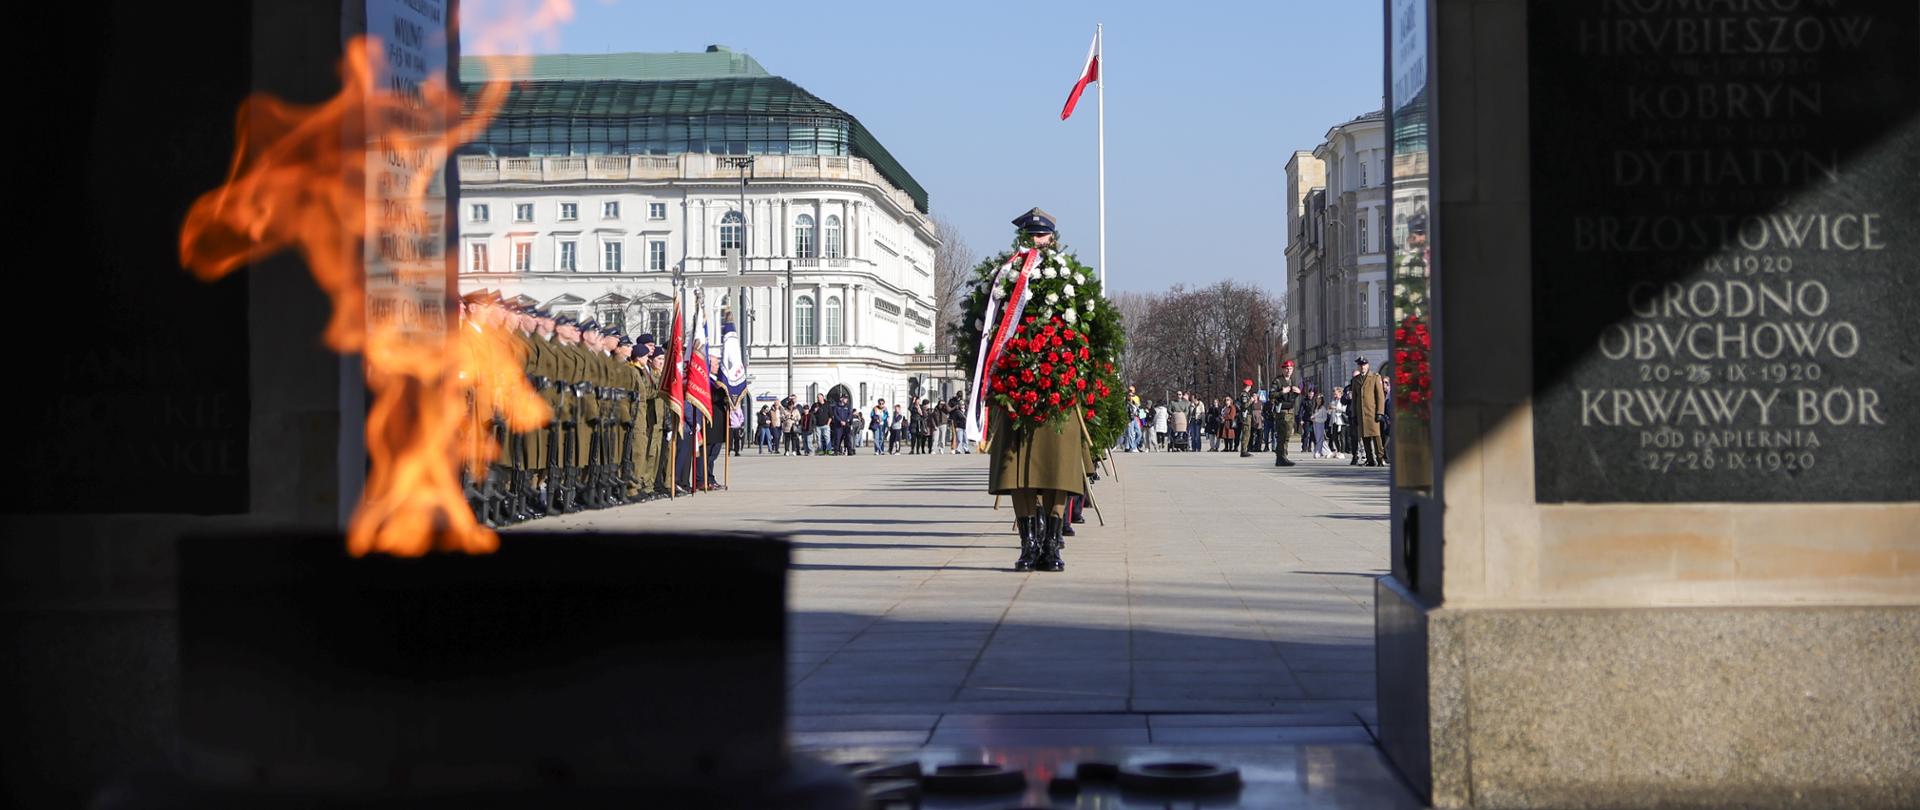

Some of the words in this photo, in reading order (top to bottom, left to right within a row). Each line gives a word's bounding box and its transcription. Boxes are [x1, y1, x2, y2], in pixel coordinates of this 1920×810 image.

[1627, 82, 1822, 120] KOBRYN
[1614, 148, 1840, 187] DYTIATYN
[1574, 212, 1887, 251] BRZOSTOWICE
[1627, 280, 1829, 318] GRODNO
[1599, 321, 1860, 360] OBVCHOWO
[1580, 387, 1782, 426] KRWAWY
